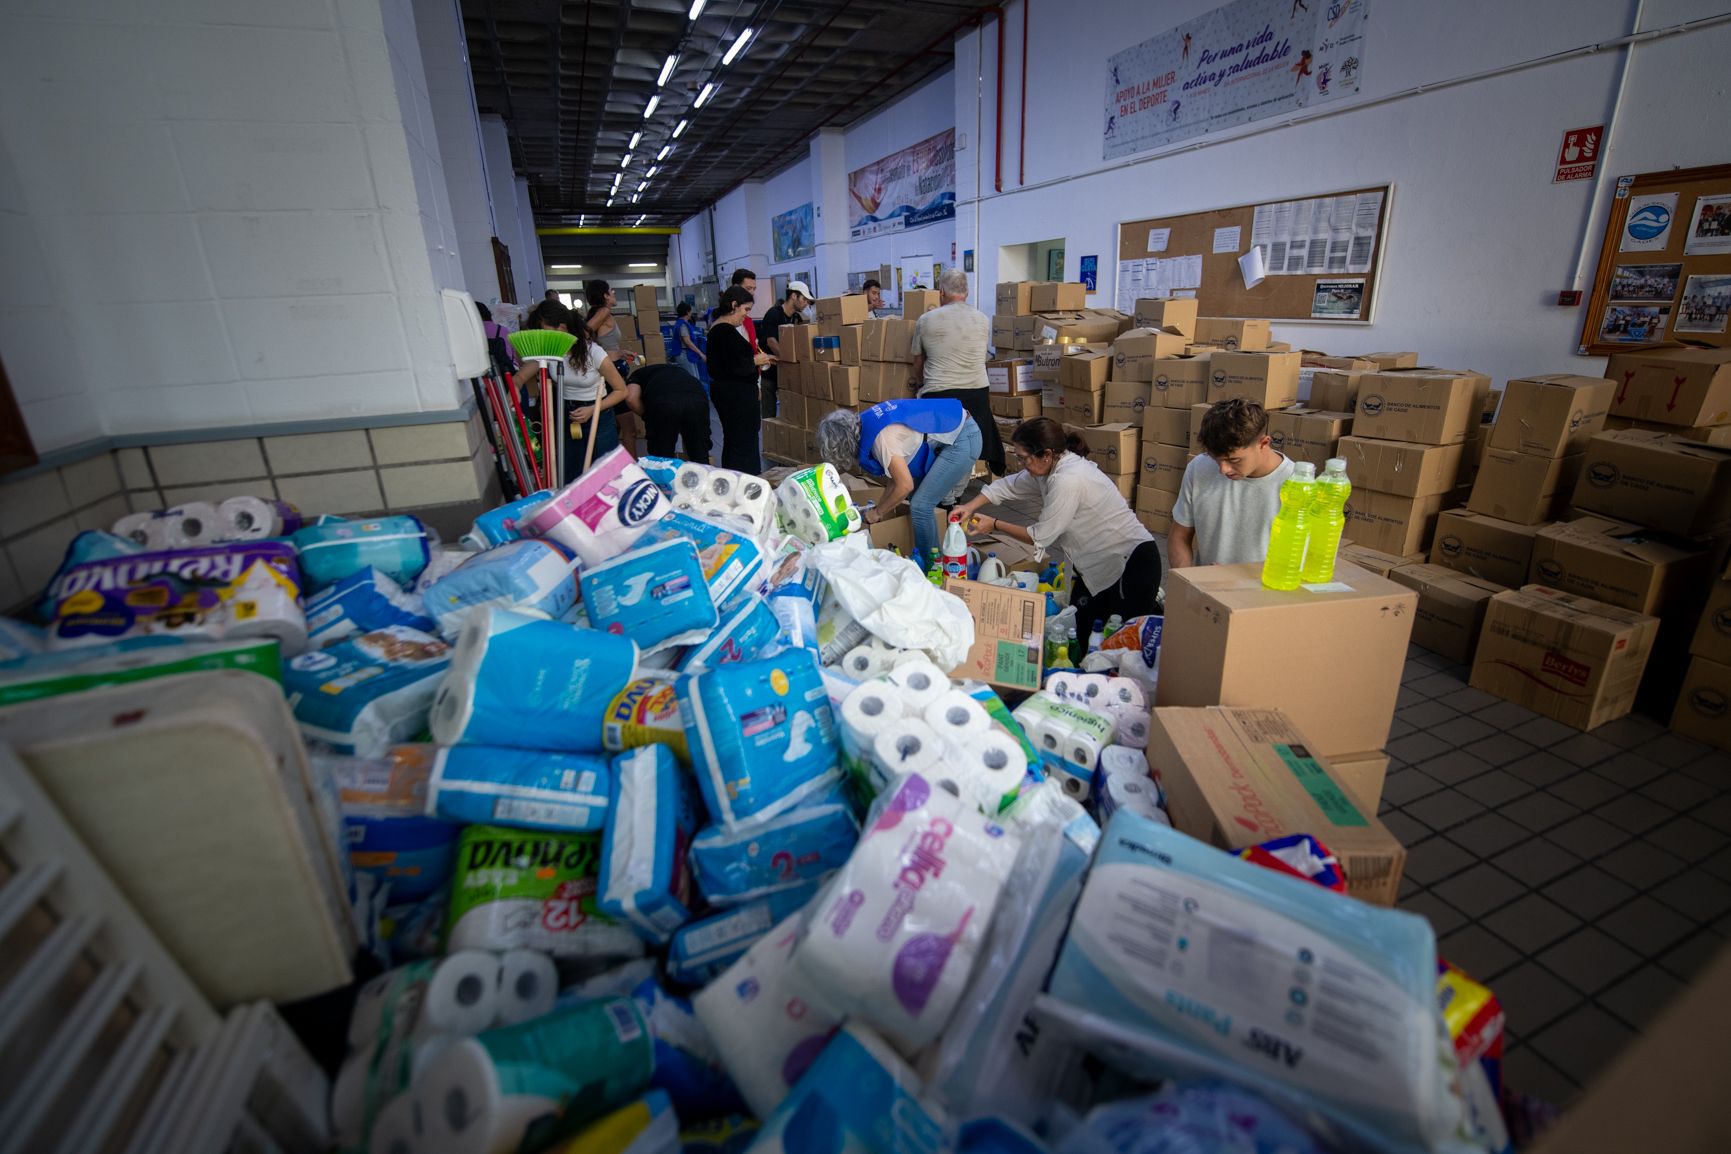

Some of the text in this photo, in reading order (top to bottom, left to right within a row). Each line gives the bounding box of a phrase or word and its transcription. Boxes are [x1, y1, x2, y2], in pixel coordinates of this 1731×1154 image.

[1197, 24, 1274, 69] Por una vida
[1182, 38, 1291, 91] activa y saludable
[1115, 86, 1135, 104] APOYO
[1142, 80, 1150, 94] LA
[1152, 71, 1176, 89] MUJER
[1120, 89, 1168, 118] EN EL DEPORTE
[1560, 165, 1592, 174] PULSADOR
[633, 485, 658, 519] NICKY
[544, 899, 586, 931] 12
